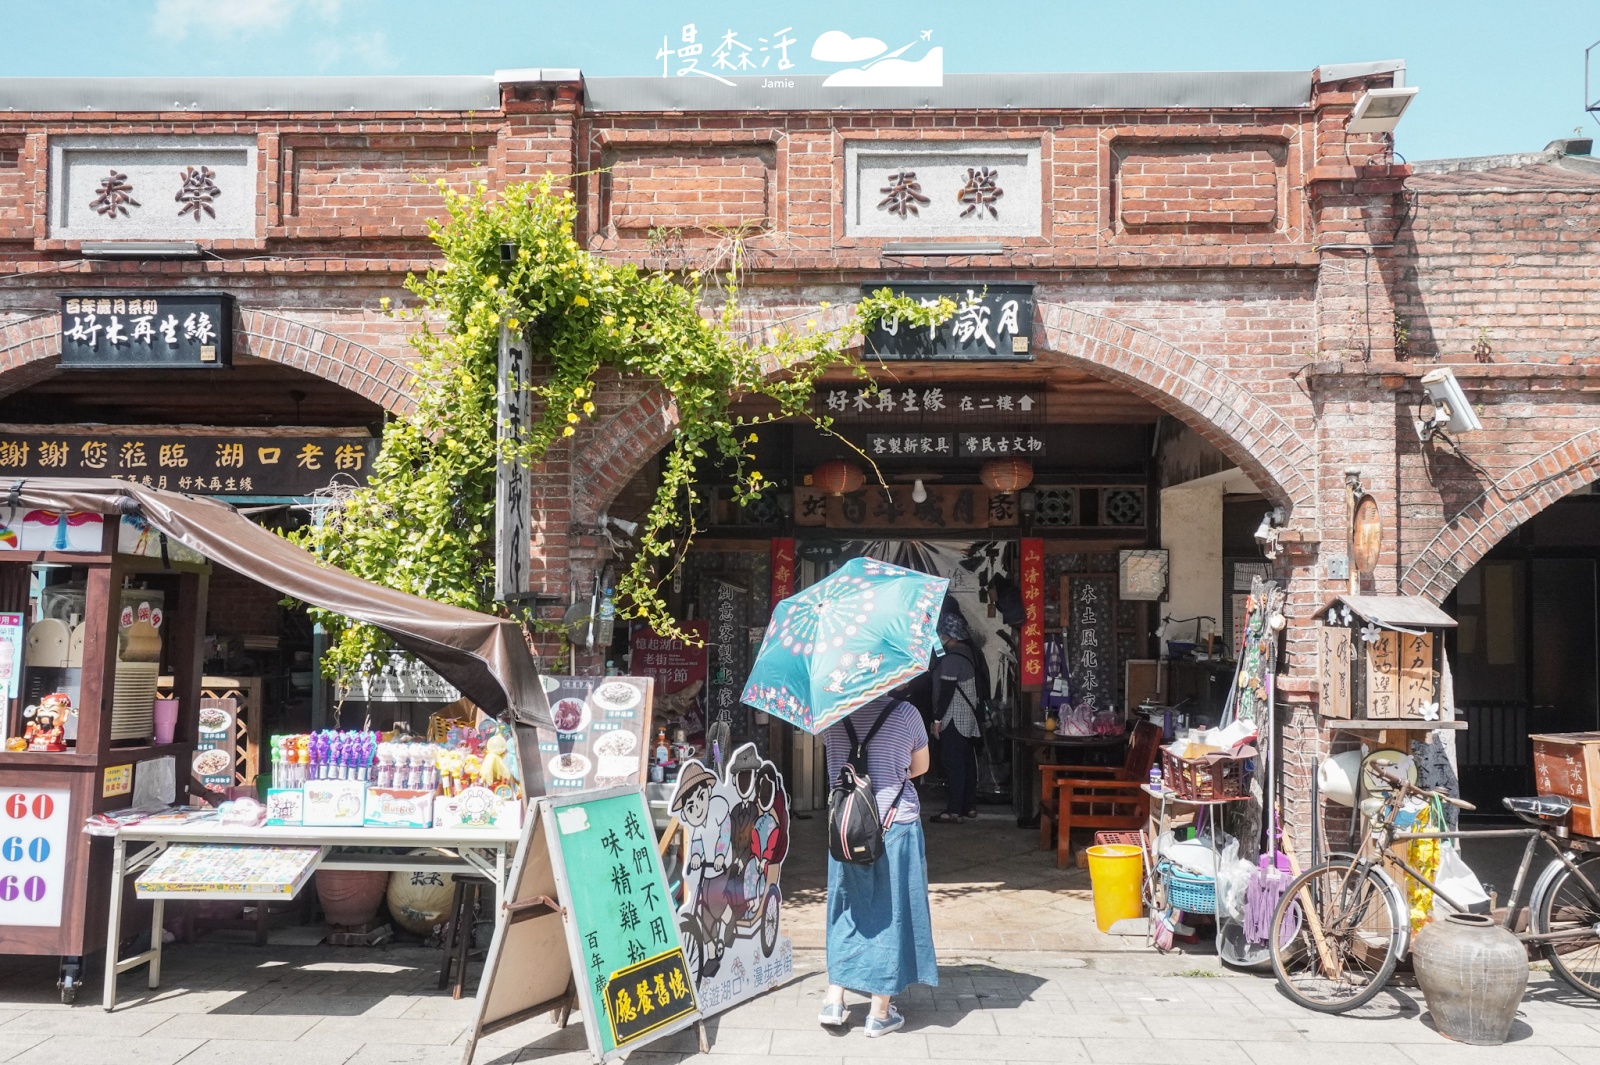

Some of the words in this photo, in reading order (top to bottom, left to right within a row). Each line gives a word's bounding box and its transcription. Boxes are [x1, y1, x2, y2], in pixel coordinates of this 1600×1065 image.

[66, 298, 158, 315] 百年歲月系列
[64, 312, 216, 346] 好木再生緣
[826, 387, 947, 412] 好木再生緣
[958, 395, 1015, 412] 在二樓
[0, 440, 189, 470] 謝謝您蒞臨
[215, 442, 366, 471] 湖口老街
[873, 437, 950, 454] 客製新家具
[965, 436, 1042, 453] 常民古文物
[178, 476, 254, 491] 好木再生緣
[1024, 550, 1041, 675] 山清水秀風光好
[636, 637, 683, 651] 憶起湖口
[643, 652, 667, 666] 老街
[5, 793, 54, 819] 60
[2, 836, 51, 863] 60
[0, 875, 46, 902] 60
[624, 810, 668, 948] 我們不用
[601, 828, 648, 966] 味精雞粉
